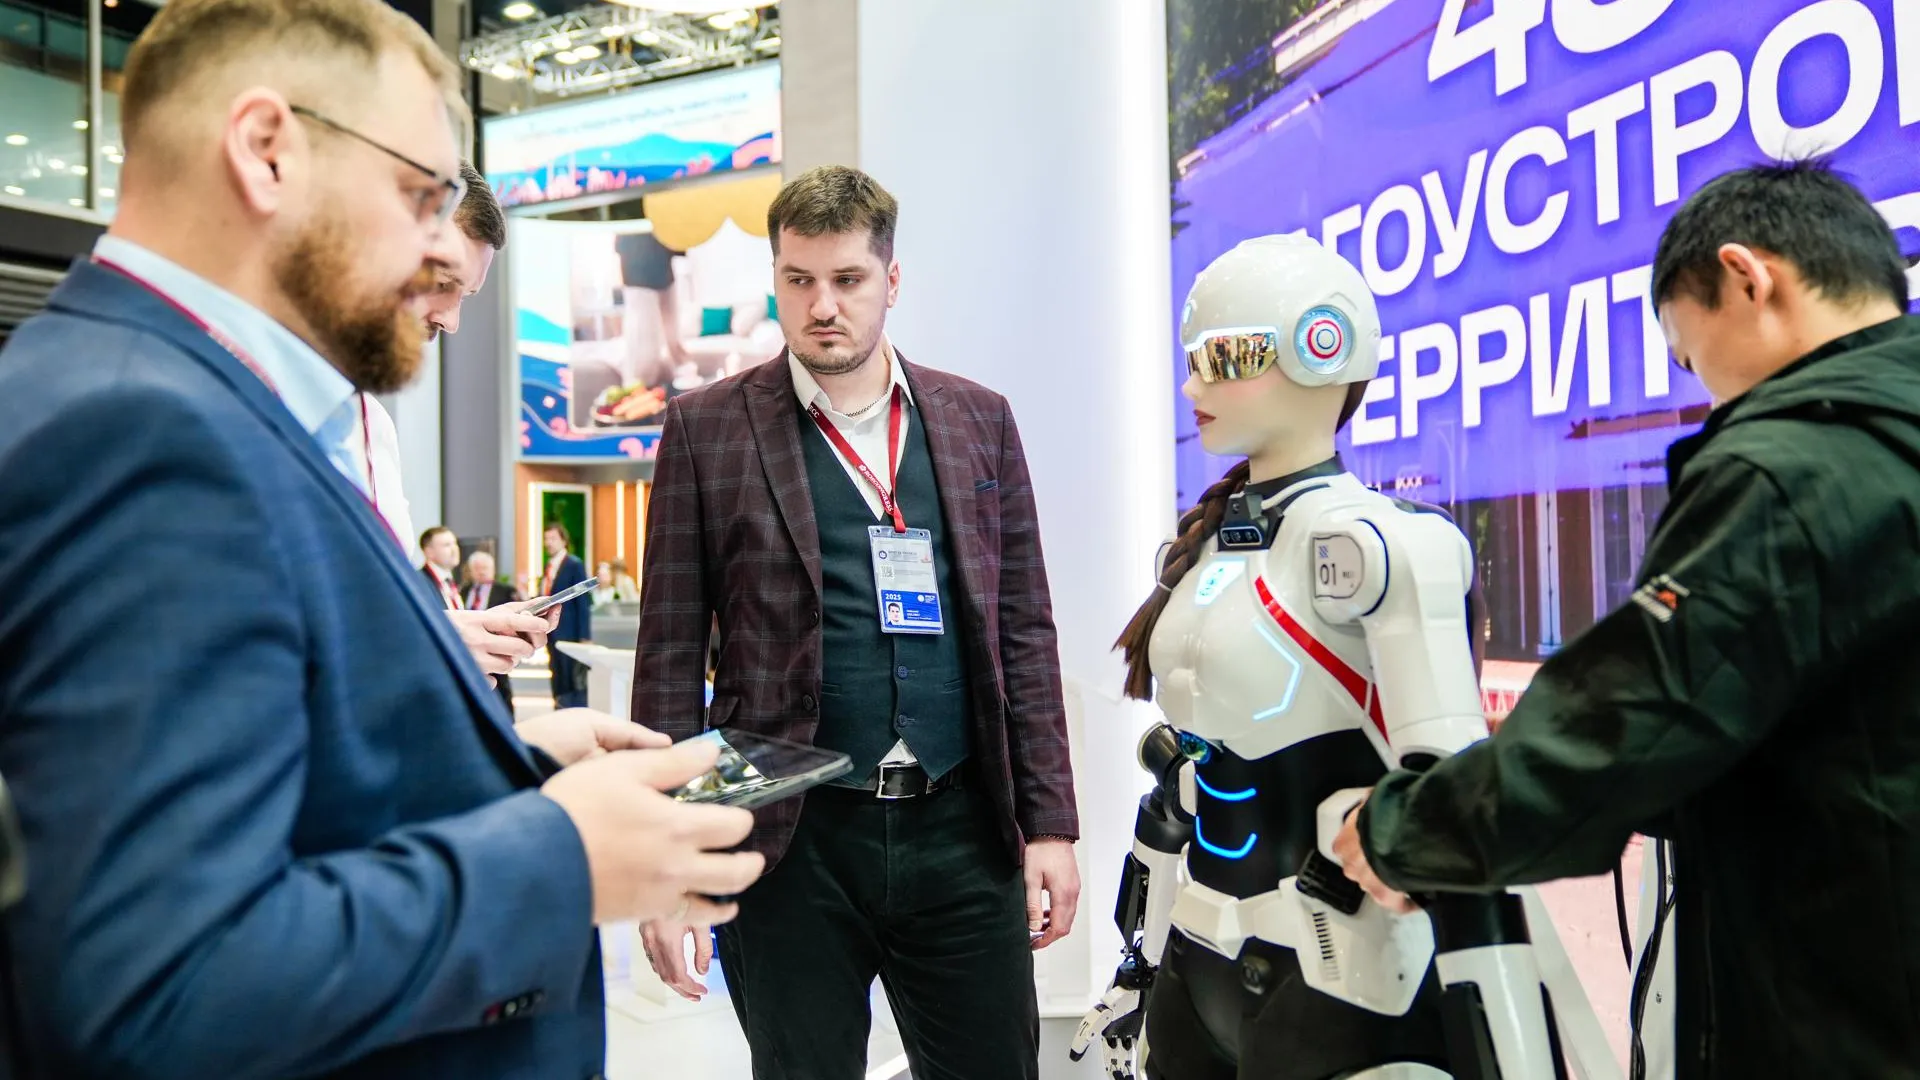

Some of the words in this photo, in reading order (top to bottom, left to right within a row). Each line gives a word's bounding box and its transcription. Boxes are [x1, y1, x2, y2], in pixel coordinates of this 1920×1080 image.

[1428, 0, 1675, 96] 4
[1287, 0, 1920, 297] ГОУСТРО
[885, 593, 902, 601] 2025
[1319, 563, 1337, 586] 01
